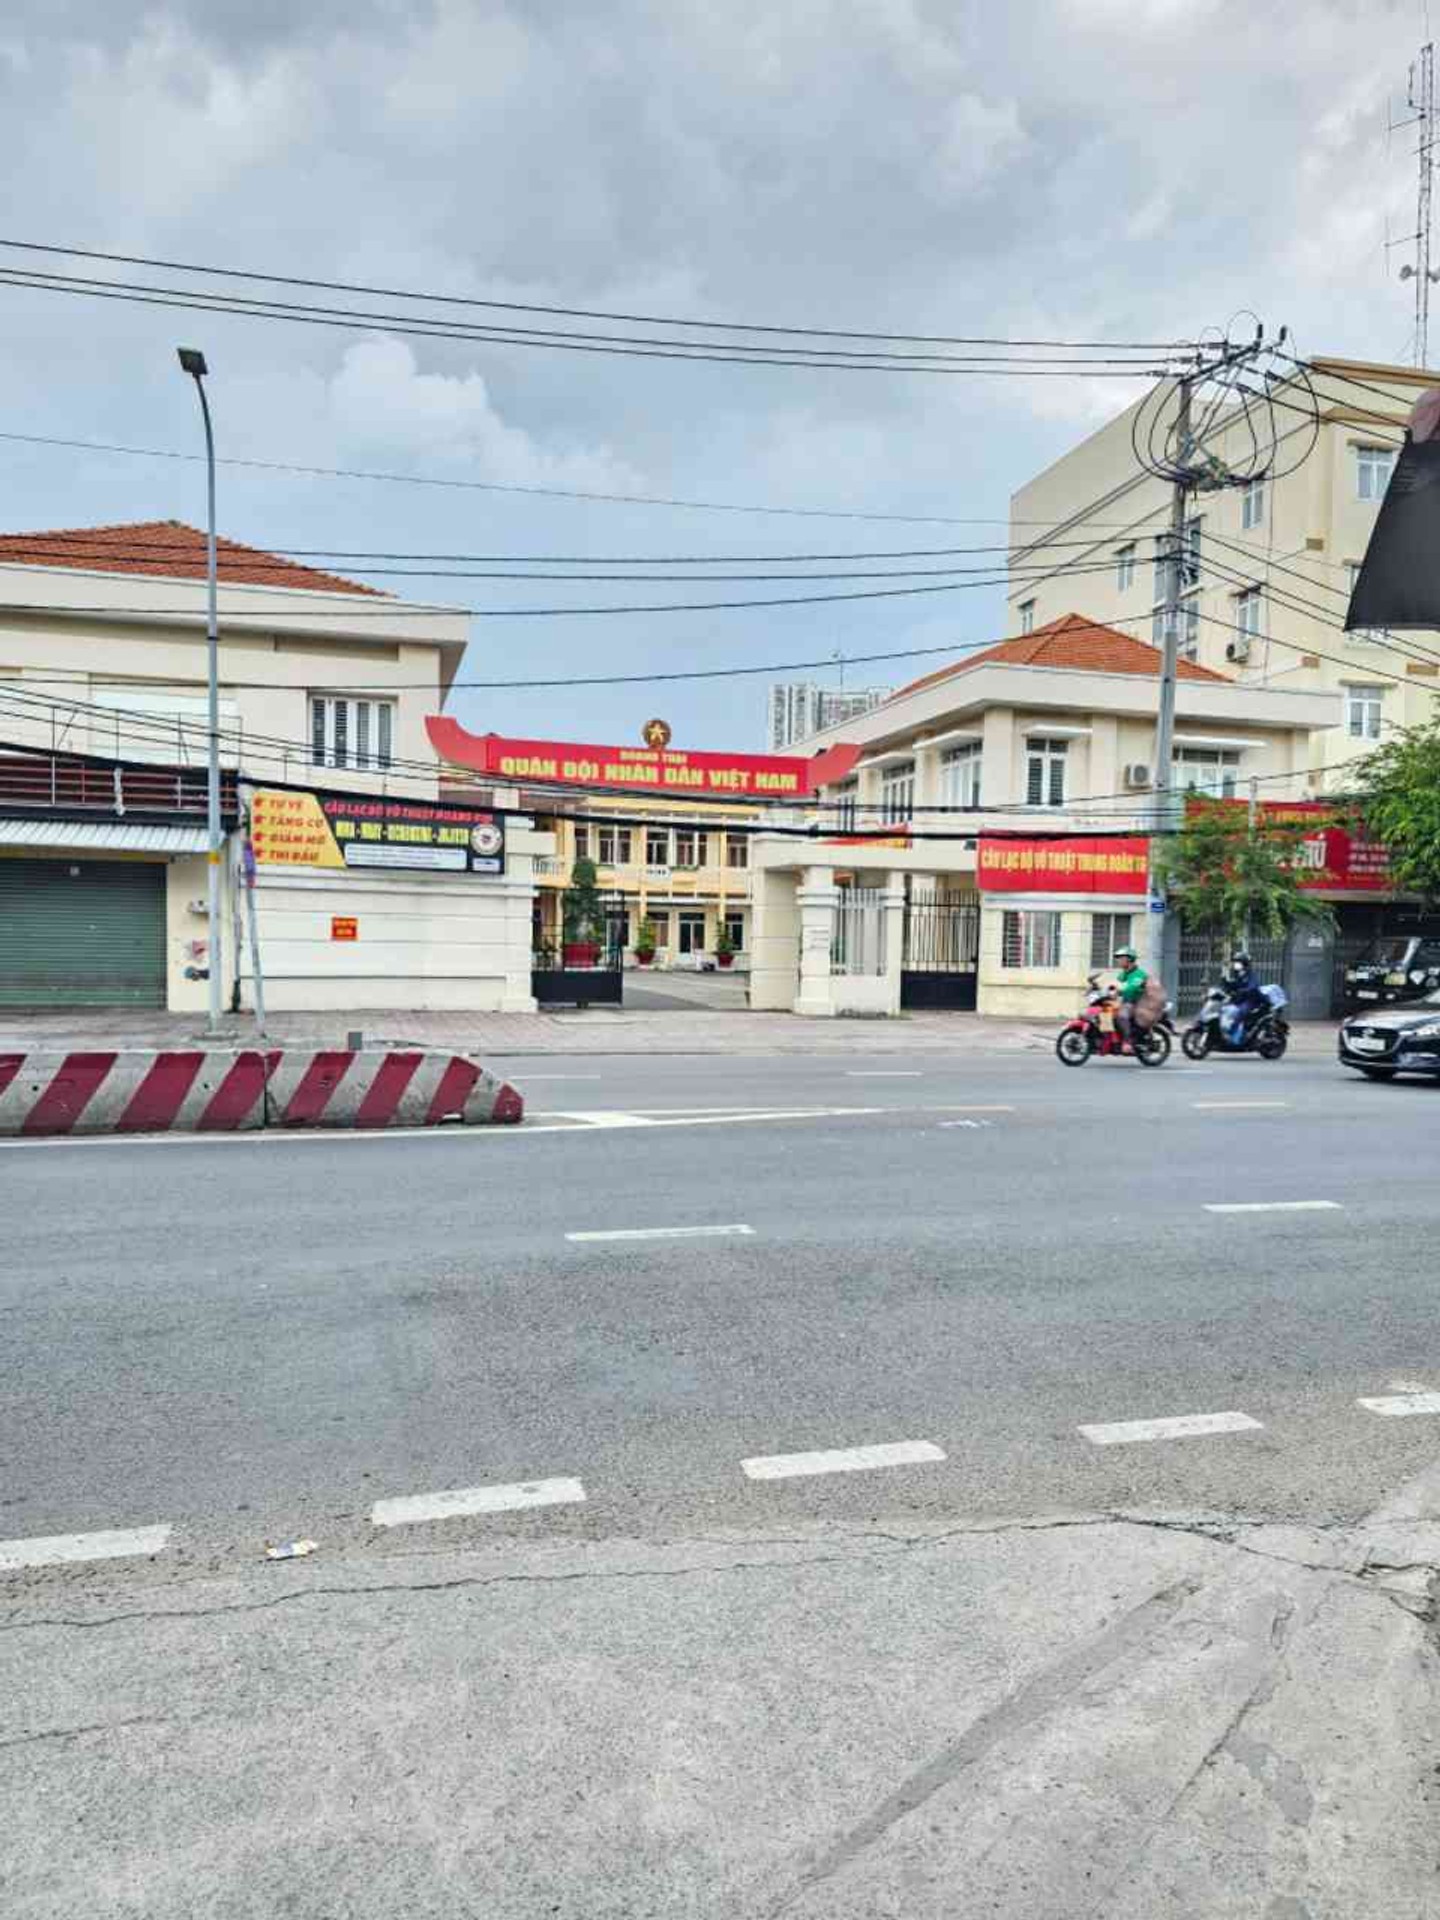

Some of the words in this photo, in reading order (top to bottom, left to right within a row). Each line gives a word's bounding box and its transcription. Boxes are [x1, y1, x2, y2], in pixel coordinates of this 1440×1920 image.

[500, 757, 557, 777] QUÂN
[563, 761, 598, 783] ĐỘI
[605, 763, 659, 783] NHÂN
[665, 766, 703, 785] DÂN
[708, 768, 749, 790] VIỆT
[755, 772, 797, 791] NAM
